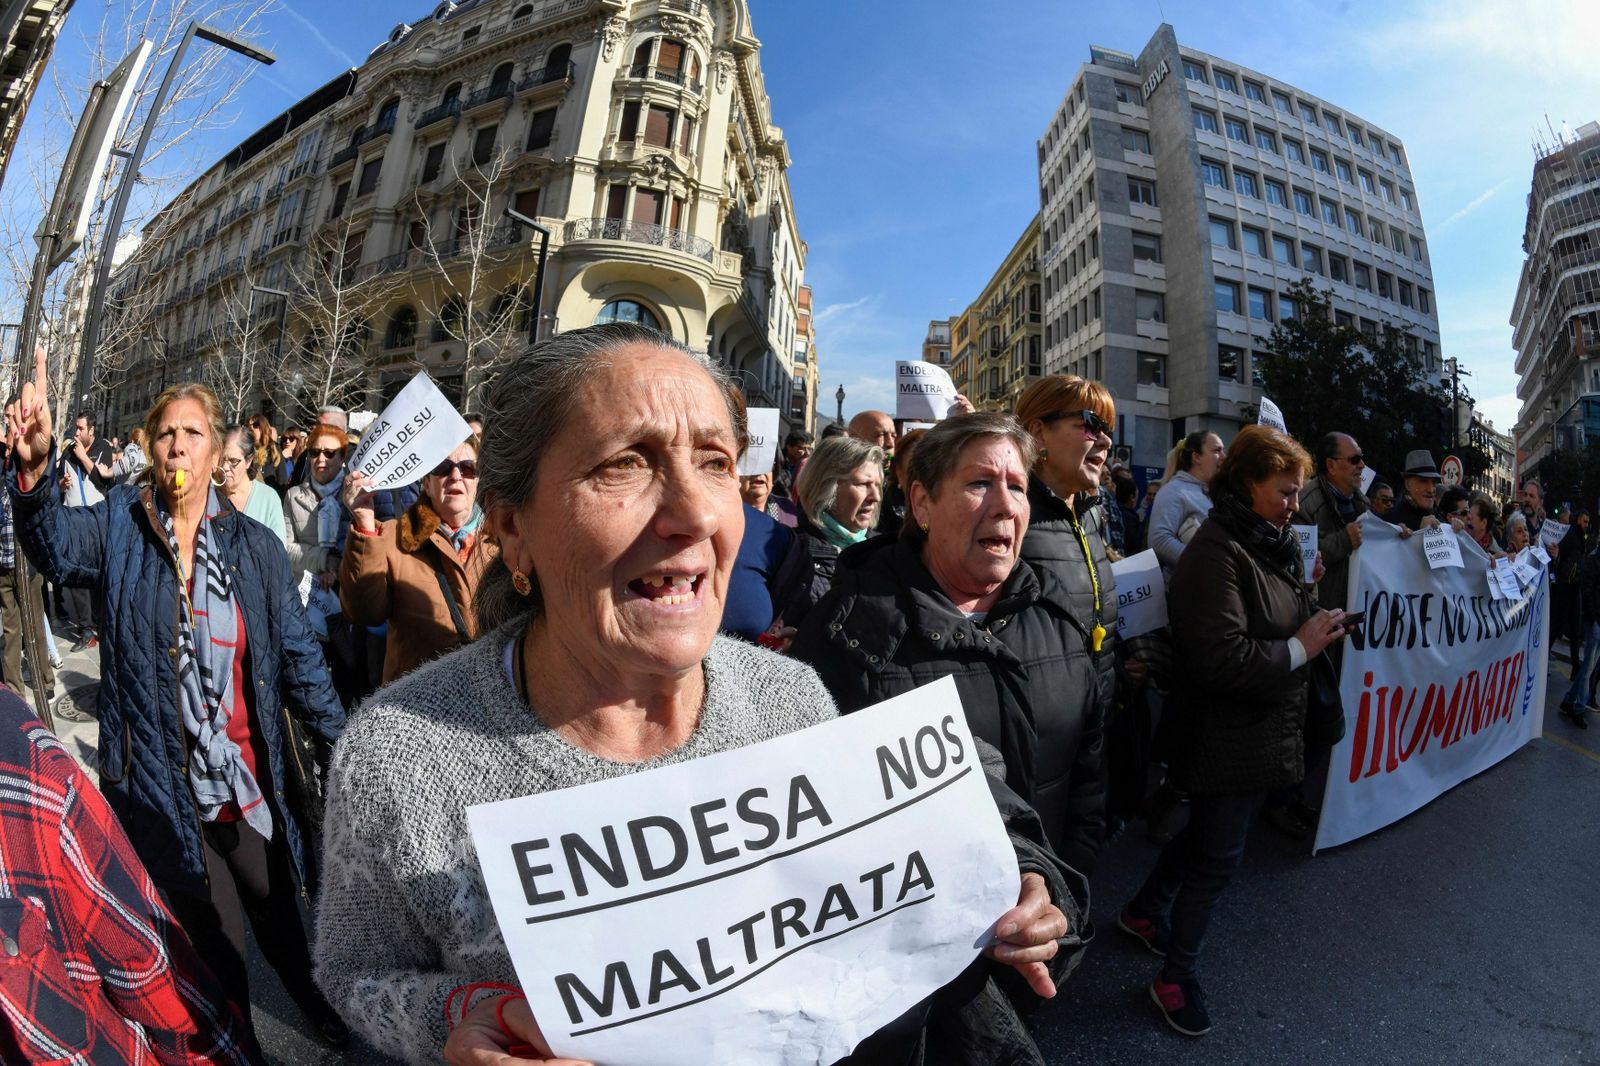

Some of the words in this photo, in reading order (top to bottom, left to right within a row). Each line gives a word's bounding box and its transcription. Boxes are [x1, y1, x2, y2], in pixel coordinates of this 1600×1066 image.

[1143, 60, 1170, 101] BBVA
[352, 420, 391, 467] ENDESA
[360, 441, 398, 479] ABUSA
[396, 423, 415, 443] DE
[413, 406, 432, 427] SU
[371, 452, 421, 488] ORDER
[1118, 590, 1134, 606] DE
[1136, 583, 1152, 600] SU
[1438, 594, 1471, 647] NO
[1470, 595, 1492, 642] TE
[511, 774, 833, 906] ENDESA
[875, 714, 966, 800] NOS
[553, 850, 935, 1025] MALTRATA
